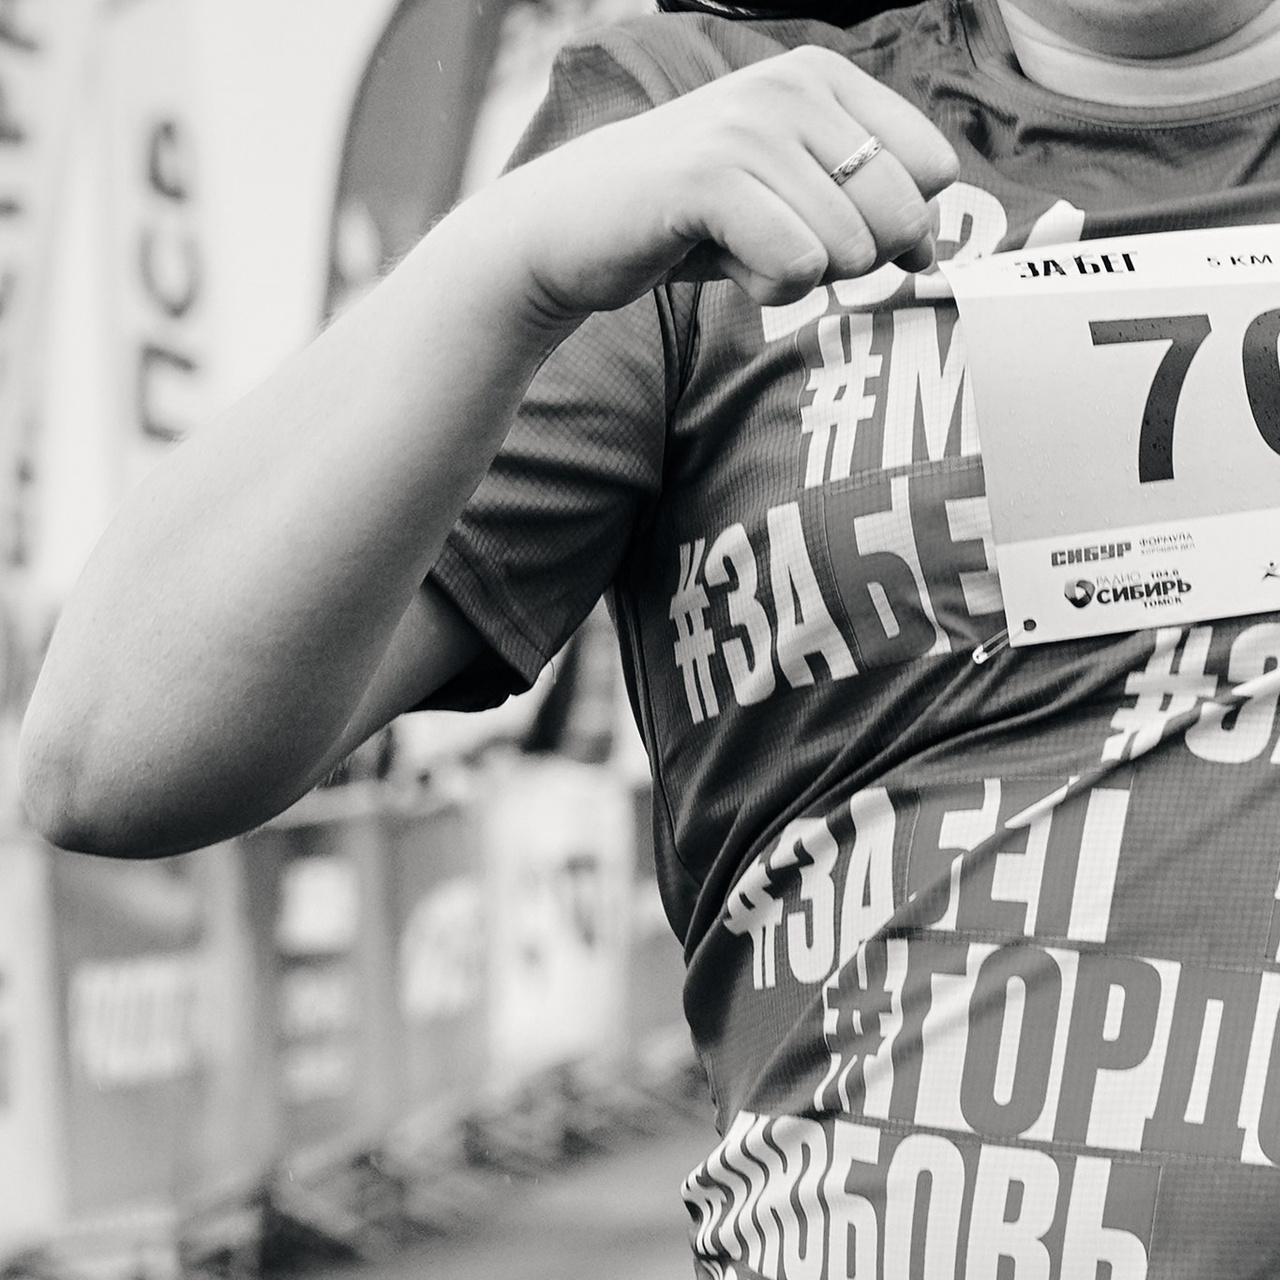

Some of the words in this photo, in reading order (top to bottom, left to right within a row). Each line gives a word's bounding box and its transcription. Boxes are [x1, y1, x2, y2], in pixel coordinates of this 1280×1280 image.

[1206, 256, 1221, 268] 5
[1230, 254, 1273, 266] КМ
[1139, 531, 1194, 547] ФОРМУЛА
[1051, 541, 1132, 567] СИБУР
[1096, 570, 1142, 588] РАДИО
[1096, 578, 1192, 605] СИБИРЬ
[1143, 595, 1182, 609] ТОМСК
